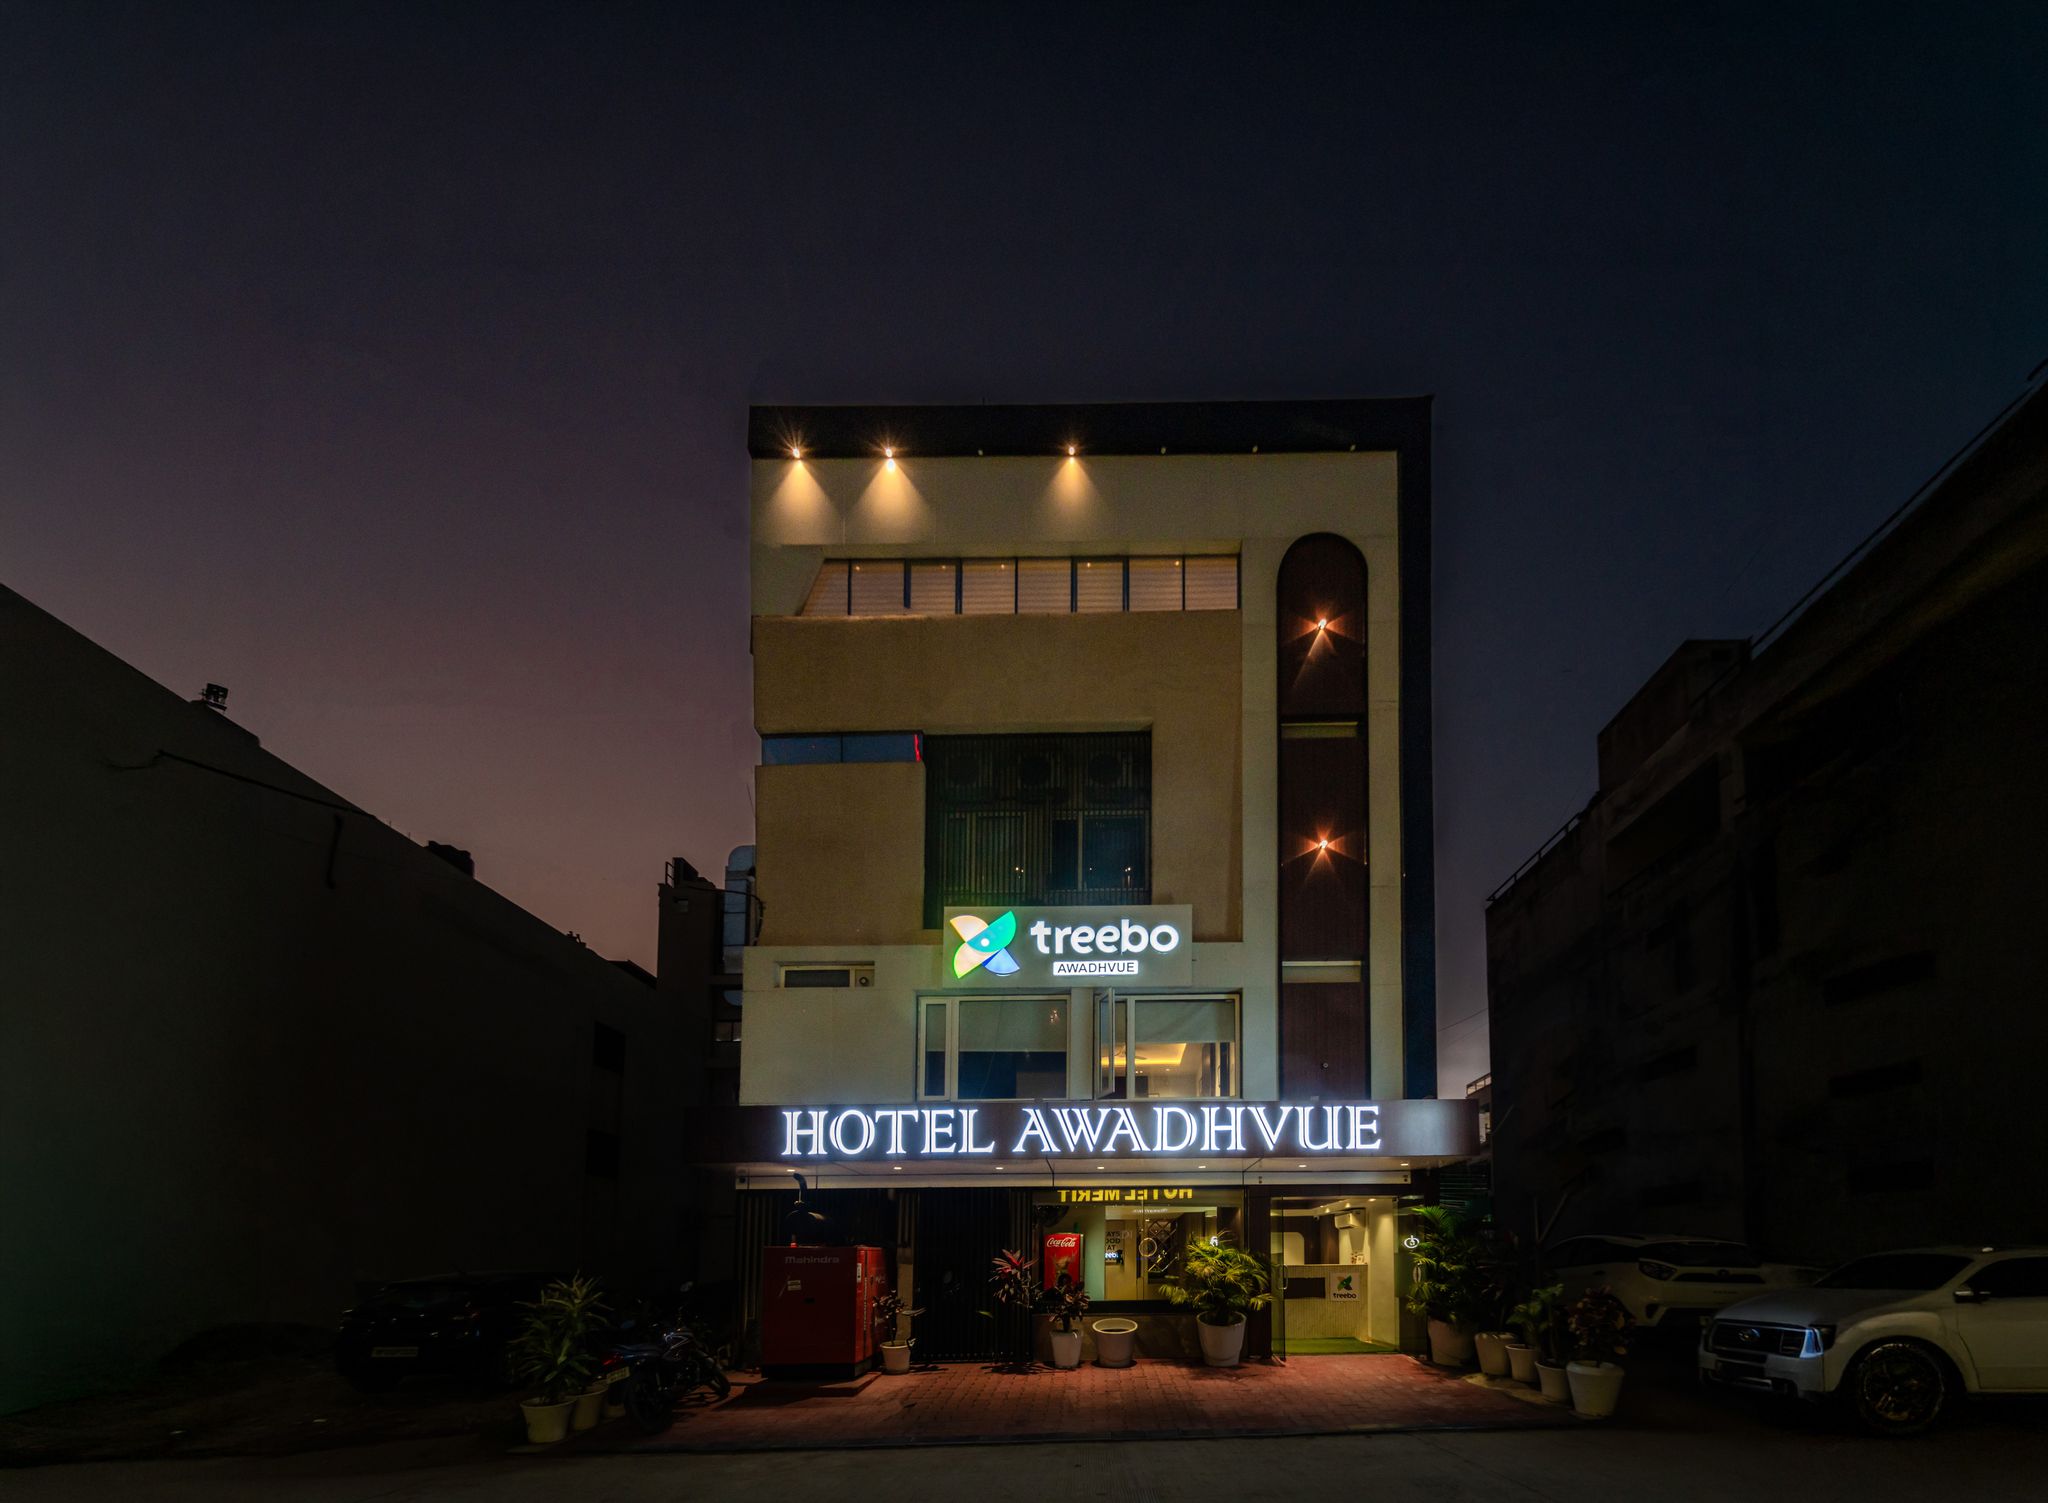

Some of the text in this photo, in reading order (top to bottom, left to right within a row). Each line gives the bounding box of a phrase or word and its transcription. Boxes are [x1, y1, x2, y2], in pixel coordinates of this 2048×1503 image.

[1030, 919, 1179, 954] treebo
[1057, 962, 1135, 974] AWADHVUE
[781, 1105, 1381, 1156] HOTEL AWADHVUE
[1046, 1237, 1076, 1248] Coca-Cola
[784, 1255, 840, 1265] Mahindra
